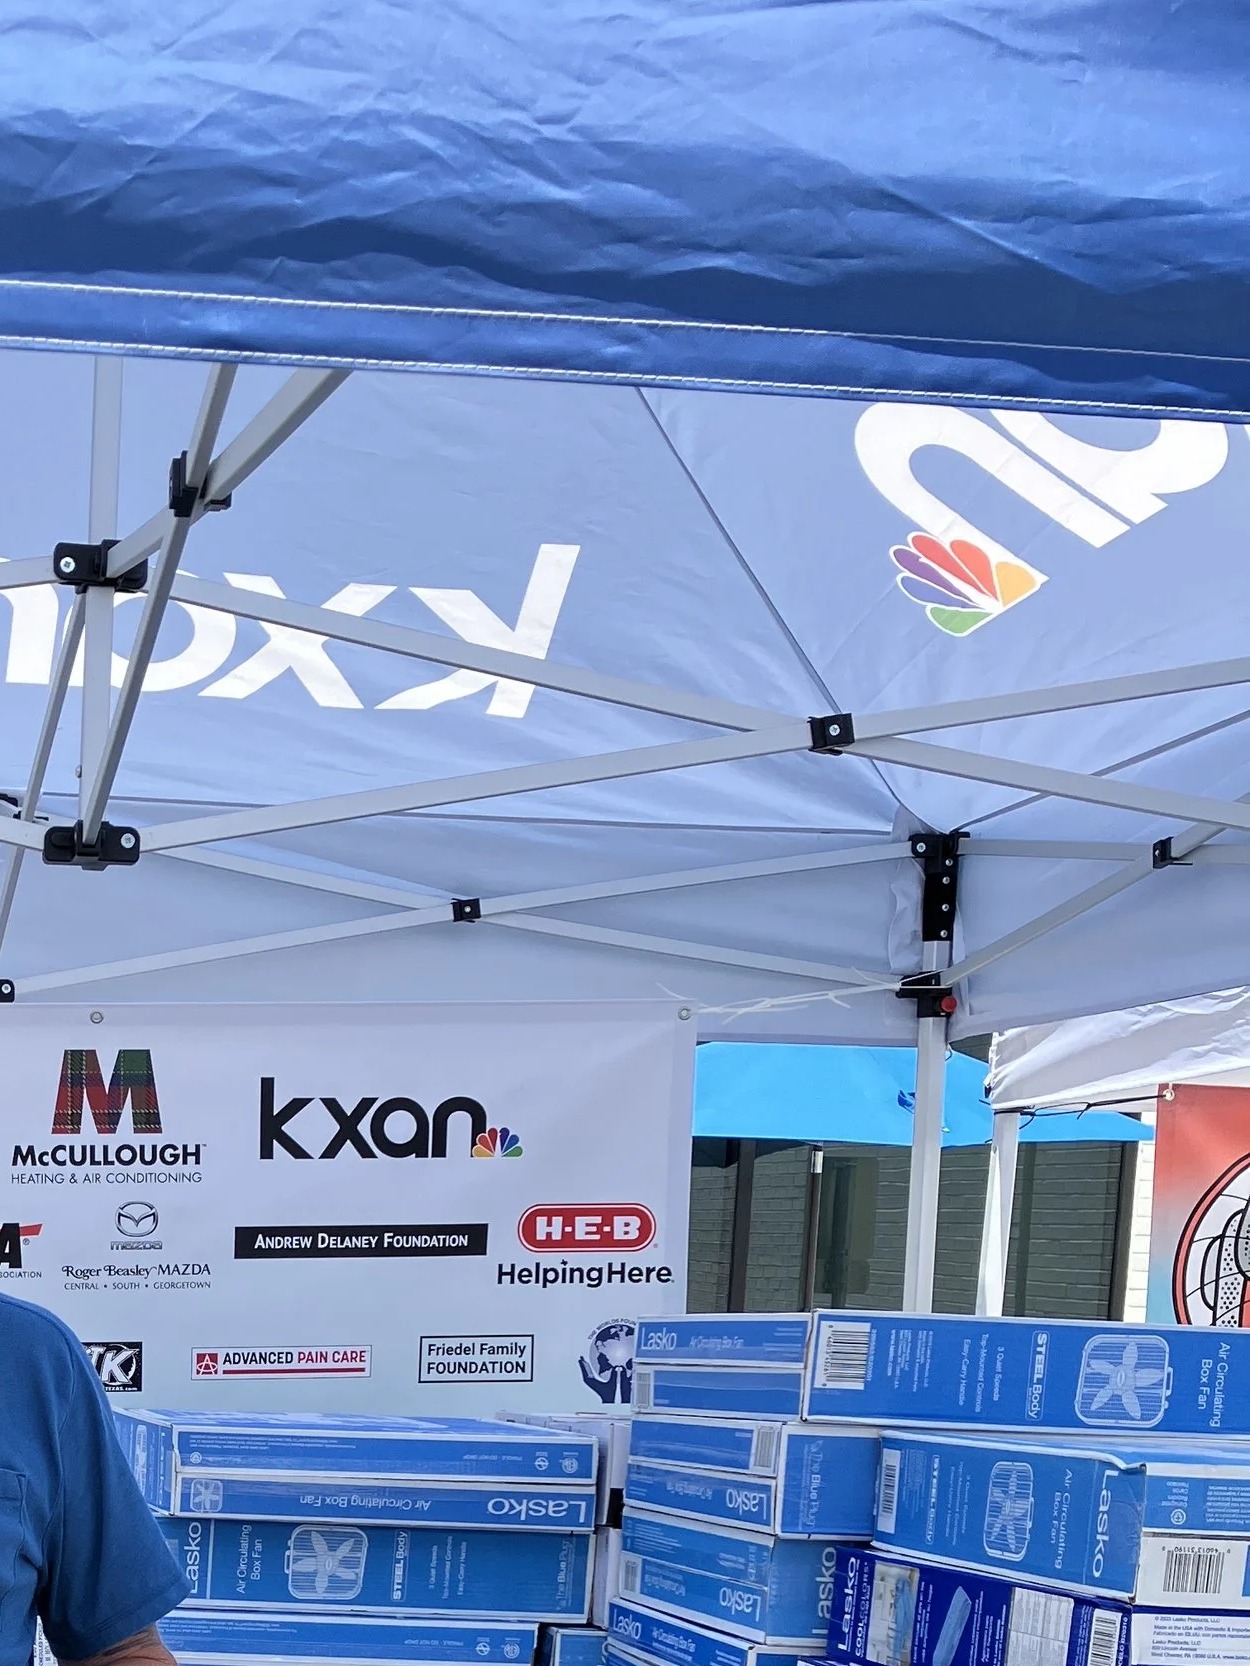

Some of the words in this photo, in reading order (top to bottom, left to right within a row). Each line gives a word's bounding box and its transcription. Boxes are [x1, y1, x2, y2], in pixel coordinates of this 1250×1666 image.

[259, 1077, 488, 1161] kxan
[11, 1143, 201, 1167] McCULLOUGH
[11, 1173, 65, 1185] HEATING
[69, 1173, 78, 1185] &
[82, 1173, 102, 1184] AIR
[105, 1171, 203, 1184] CONDITIONING
[61, 1264, 101, 1280] Roger
[103, 1264, 151, 1280] Beasley
[157, 1263, 211, 1276] MAZDA
[64, 1282, 99, 1290] CENTRAL
[112, 1282, 140, 1290] SOUTH
[153, 1281, 211, 1290] GEORGETOWN
[222, 1351, 293, 1366] ADVANCED
[297, 1350, 328, 1364] PAIN
[332, 1350, 366, 1363] CARE
[427, 1343, 476, 1357] Friedel
[479, 1342, 526, 1359] Family
[1219, 1342, 1231, 1360] Air
[427, 1359, 526, 1376] FOUNDATION
[1199, 1359, 1213, 1383] Box
[1197, 1386, 1210, 1410] Fan
[1209, 1362, 1229, 1428] Circulating
[1061, 1469, 1073, 1487] Air
[299, 1494, 323, 1506] Fan
[324, 1496, 349, 1507] Box
[351, 1497, 412, 1511] Circulating
[413, 1498, 432, 1511] Air
[486, 1497, 586, 1523] Lasko
[726, 1488, 767, 1520] Lasko
[1051, 1491, 1062, 1519] Box
[1050, 1521, 1058, 1545] Fan
[1054, 1491, 1071, 1570] Circulating
[1092, 1469, 1119, 1578] Lasko
[236, 1524, 252, 1578] Circulating
[252, 1538, 262, 1559] Fan
[251, 1561, 262, 1582] Box
[236, 1579, 246, 1594] Air
[812, 1546, 837, 1639] Lasko
[719, 1587, 762, 1622] Lasko
[837, 1557, 856, 1652] Lasko
